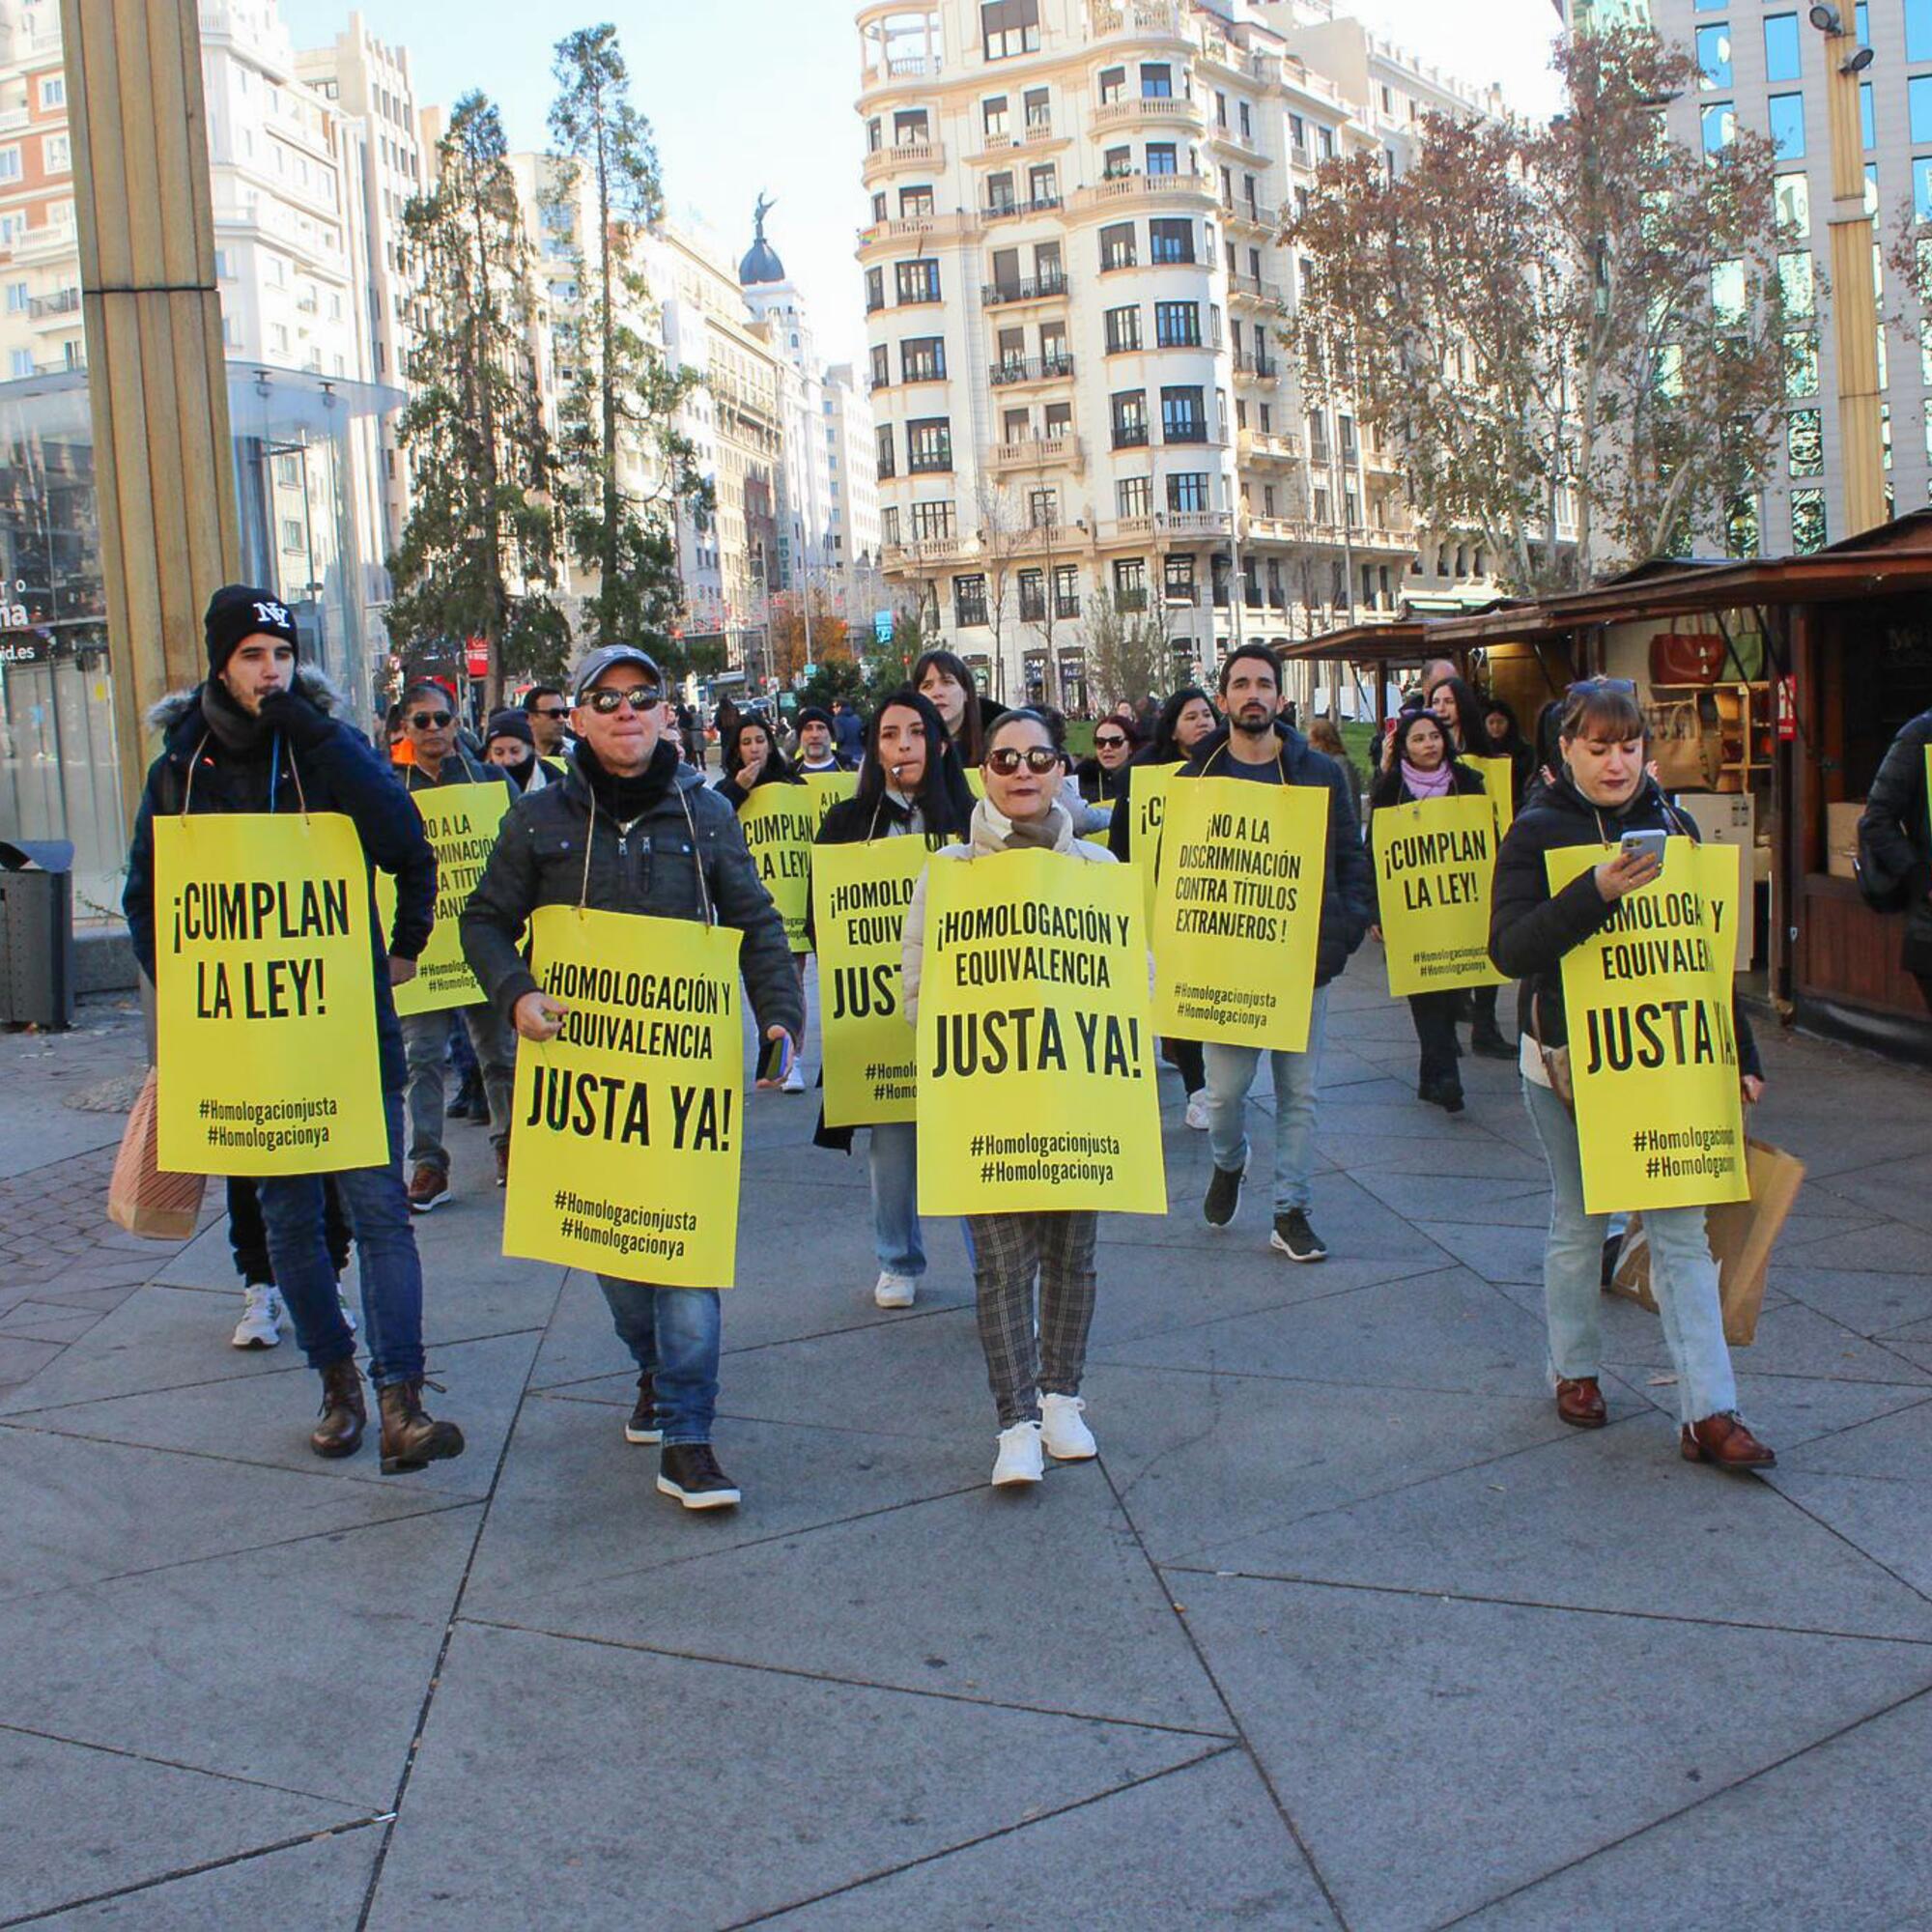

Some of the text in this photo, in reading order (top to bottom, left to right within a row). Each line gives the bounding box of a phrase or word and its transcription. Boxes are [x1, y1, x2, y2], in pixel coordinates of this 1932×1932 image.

[253, 602, 290, 628] NY
[441, 816, 452, 838] A
[454, 813, 471, 835] LA
[1236, 816, 1246, 839] A
[1251, 819, 1270, 844] LA
[1179, 845, 1301, 879] DISCRIMINACIÓN
[1384, 830, 1488, 880] ¡CUMPLAN
[831, 877, 918, 919] ¡HOMOLO
[1176, 877, 1297, 912] CONTRA TÍTULOS
[1404, 870, 1479, 911] LA LEY!
[174, 879, 350, 953] ¡CUMPLAN
[937, 902, 1129, 952] ¡HOMOLOGACIÓN Y
[1711, 899, 1724, 933] Y
[197, 957, 327, 1019] LA LEY!
[543, 960, 731, 1016] ¡HOMOLOGACIÓN Y
[956, 947, 1110, 988] EQUIVALENCIA
[1174, 980, 1278, 1009] #Homologacionjusta
[555, 1009, 712, 1060] EQUIVALENCIA
[1177, 1002, 1267, 1029] #Homologacionya
[932, 1007, 1141, 1078] JUSTA YA!
[1587, 1000, 1714, 1074] JUSTA
[199, 1097, 338, 1125] #Homologacionjusta
[526, 1065, 732, 1152] JUSTA YA!
[208, 1125, 329, 1151] #Homologacionya
[970, 1132, 1120, 1157] #Homologacionjusta
[980, 1159, 1113, 1185] #Homologacionya
[554, 1189, 697, 1234] #Homologacionjusta
[561, 1217, 685, 1261] #Homologacionya
